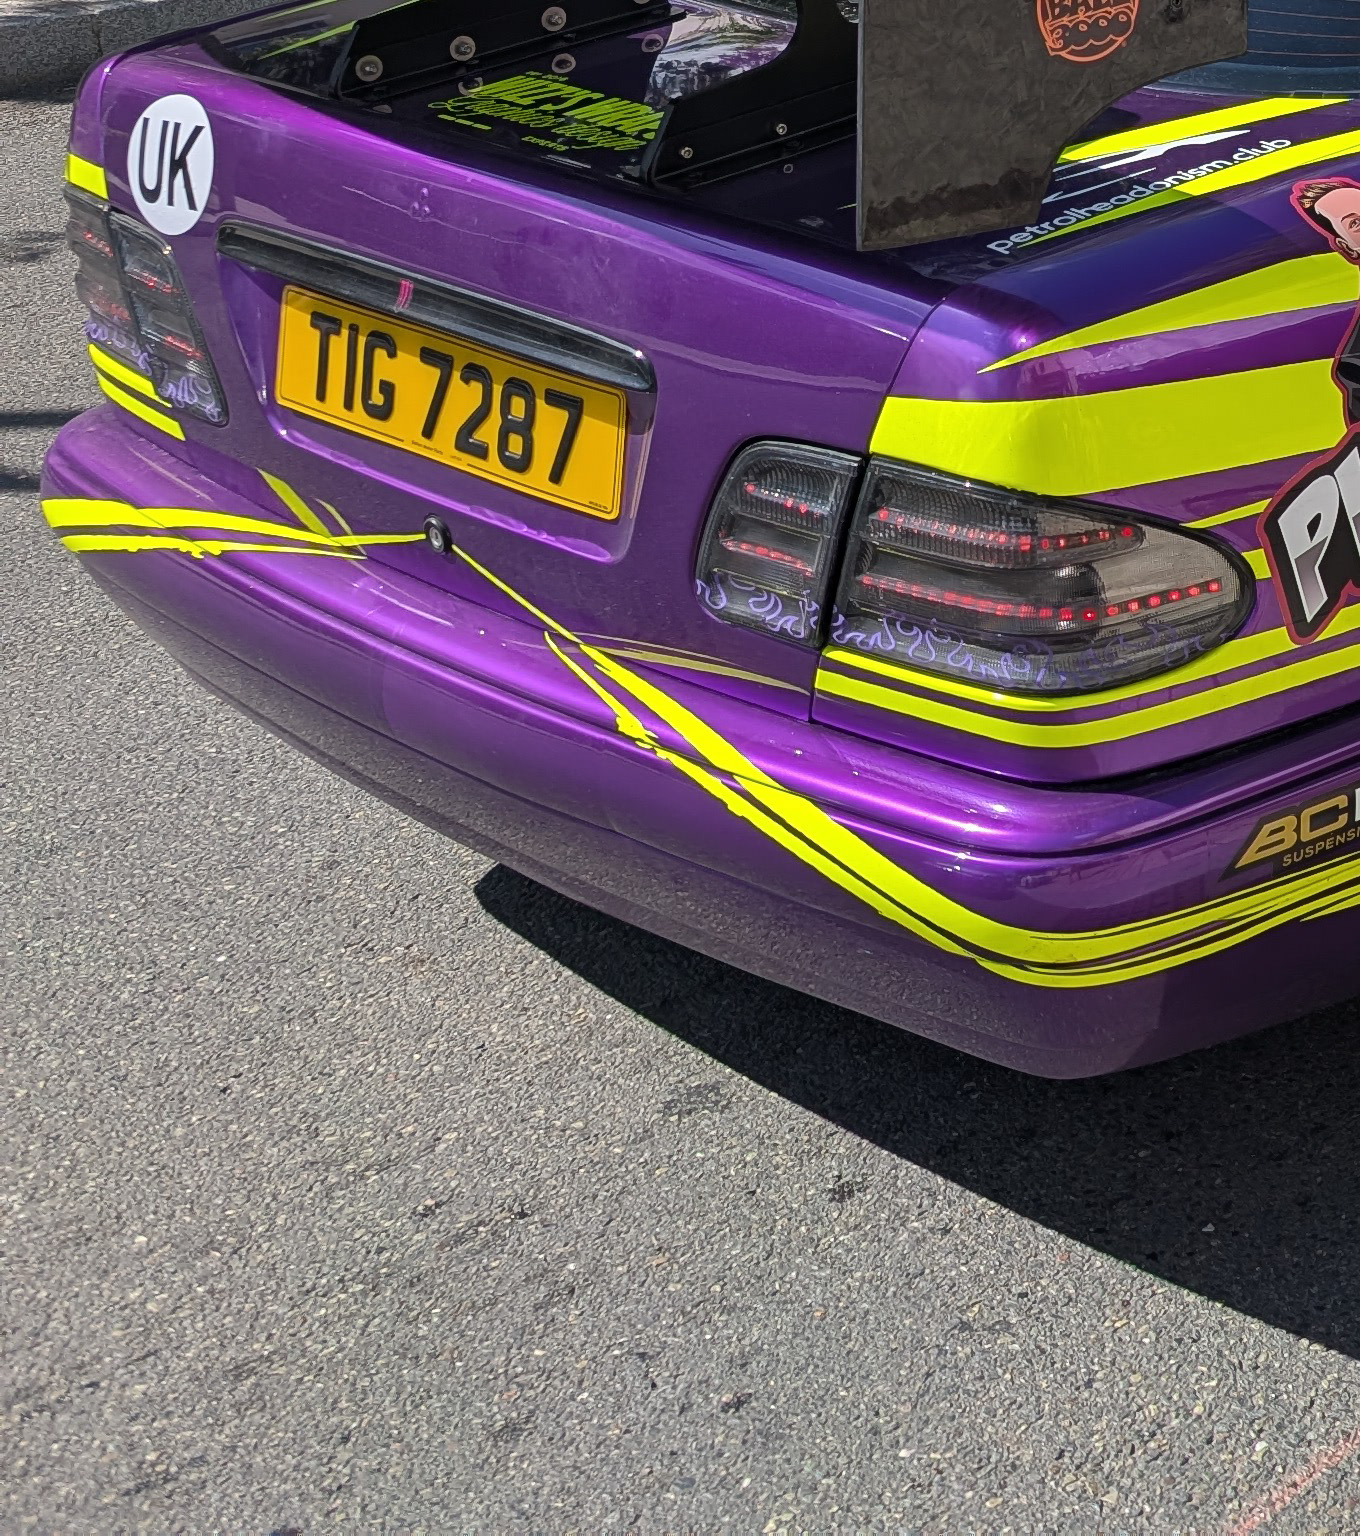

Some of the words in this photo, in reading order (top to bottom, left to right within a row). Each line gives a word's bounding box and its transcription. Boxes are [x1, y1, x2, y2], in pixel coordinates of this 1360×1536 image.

[138, 116, 206, 212] UK
[986, 138, 1293, 256] petrolheadonism.club
[309, 310, 398, 421] TIG
[417, 344, 586, 486] 7287
[1234, 793, 1349, 869] BC
